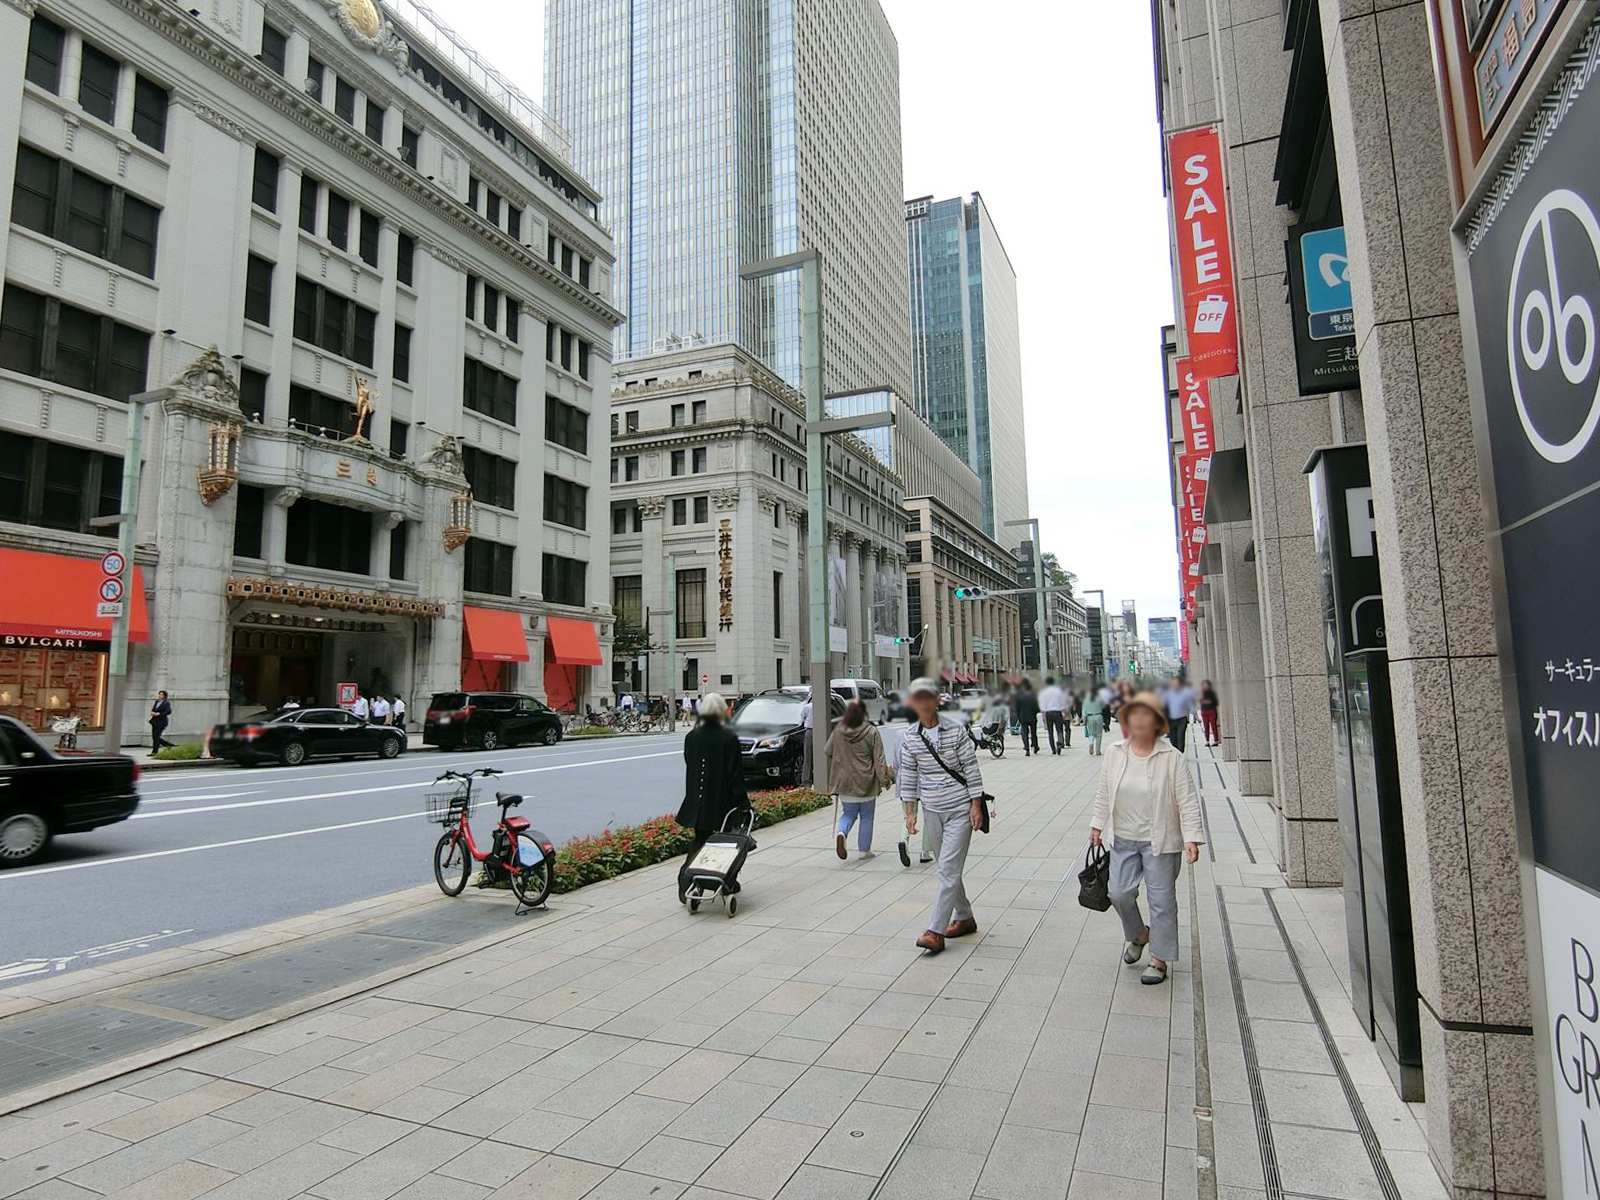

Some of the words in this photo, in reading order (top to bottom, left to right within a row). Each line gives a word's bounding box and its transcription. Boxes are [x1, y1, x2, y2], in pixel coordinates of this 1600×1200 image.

[1183, 154, 1222, 285] SALE
[1198, 312, 1223, 323] OFF
[1184, 371, 1210, 451] SALE
[106, 558, 120, 570] 50
[718, 518, 734, 632] 三井住友信託銀行
[55, 628, 103, 638] MITSUKOSHI
[4, 635, 84, 648] BVLGARI
